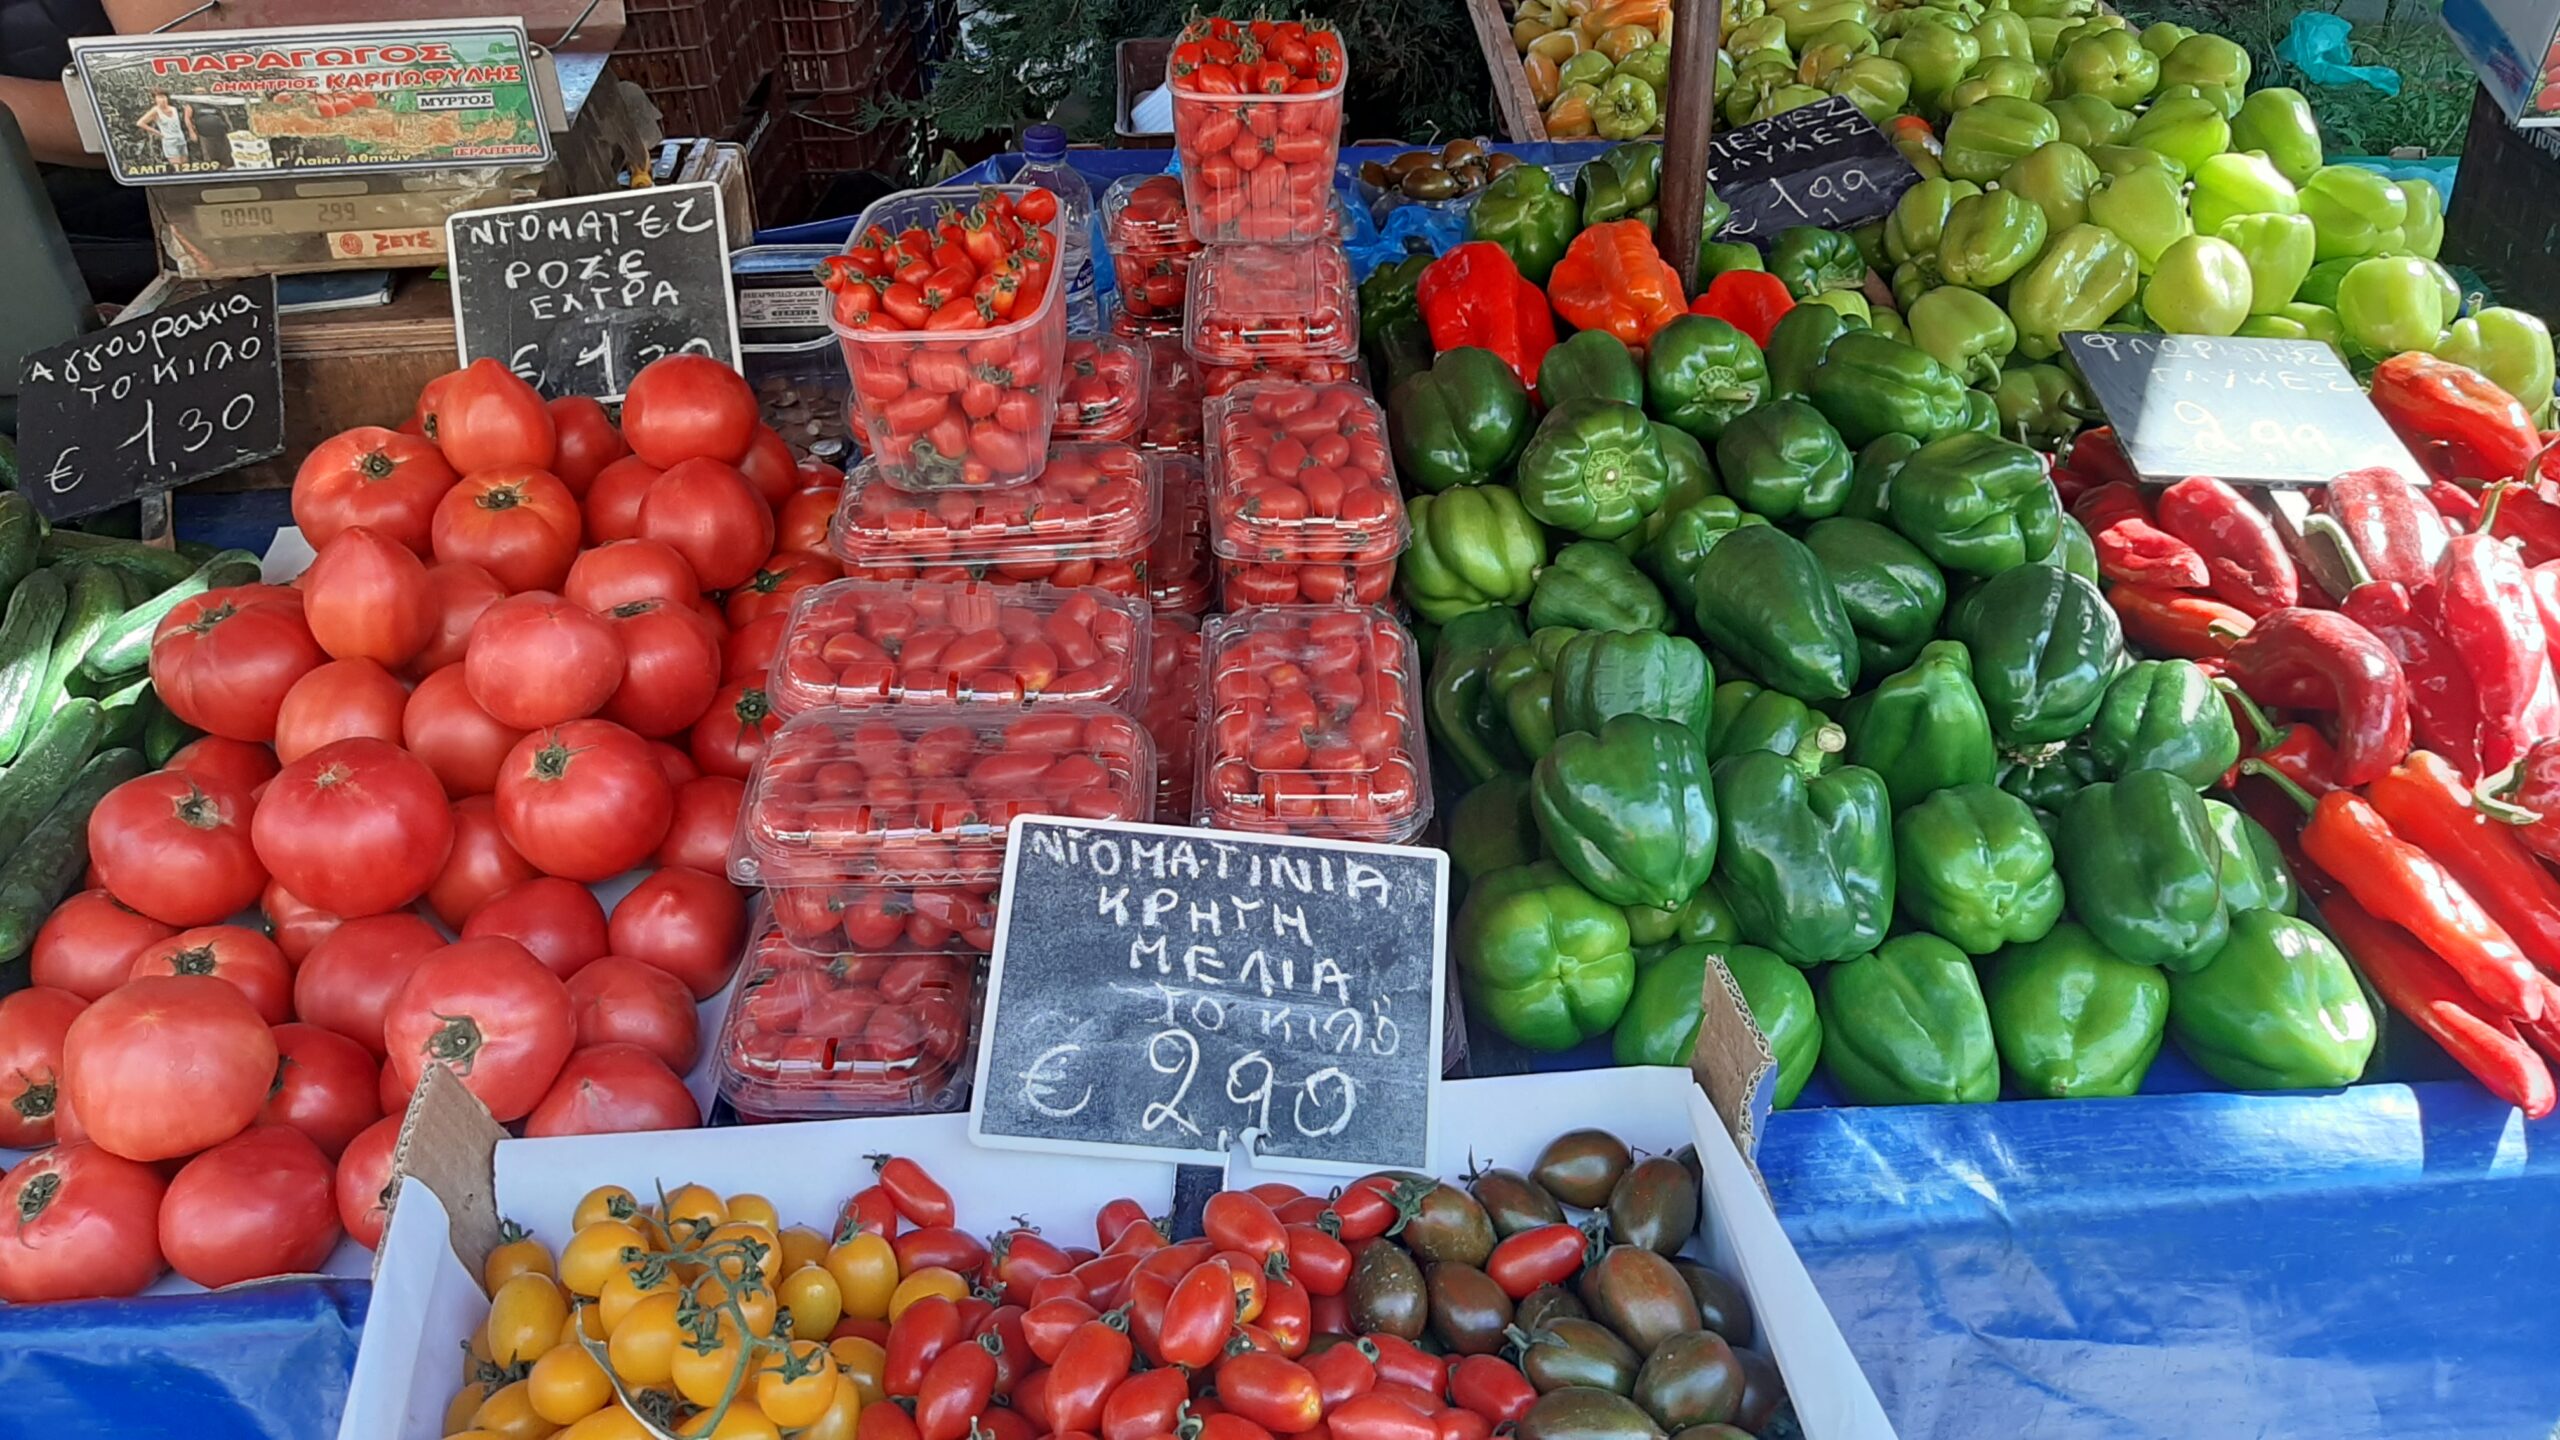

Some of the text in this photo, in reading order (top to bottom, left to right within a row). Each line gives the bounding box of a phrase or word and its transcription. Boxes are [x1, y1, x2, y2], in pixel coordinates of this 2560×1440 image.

[153, 43, 454, 76] ΠΑΡΑΓΩΓΟΣ
[212, 77, 319, 93] ΔΗΜΗΤΡΙΟΣ
[420, 93, 492, 108] ΜΥΡΤΟΣ
[346, 150, 412, 164] Αθηνών
[453, 143, 541, 157] ΙΕΡΑΠΕΤΡΑ
[128, 160, 221, 176] ΑΜΠ 12509
[44, 393, 255, 493] € 1,30
[1018, 1043, 1093, 1118] €
